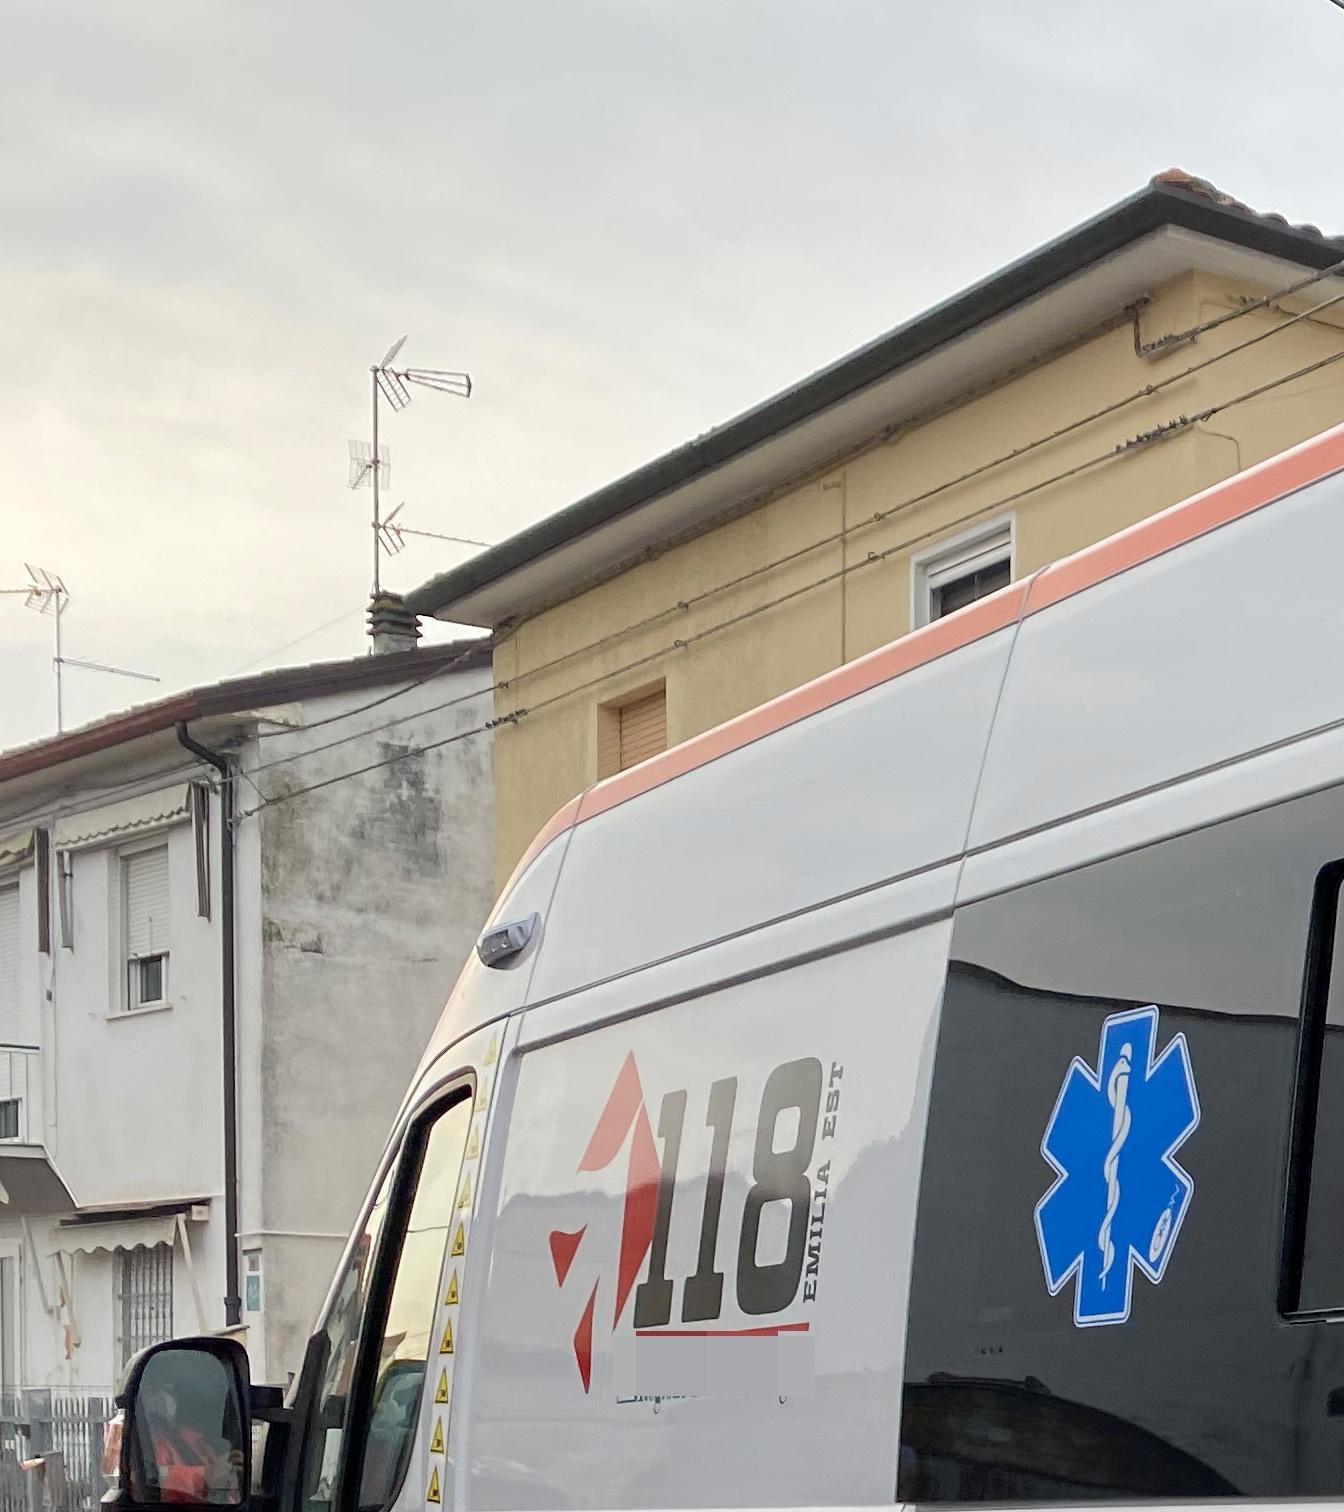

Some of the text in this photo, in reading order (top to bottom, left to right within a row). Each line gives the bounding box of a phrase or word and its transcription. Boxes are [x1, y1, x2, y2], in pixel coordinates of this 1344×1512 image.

[633, 1056, 823, 1329] 118
[803, 1061, 844, 1303] EMILIA EST
